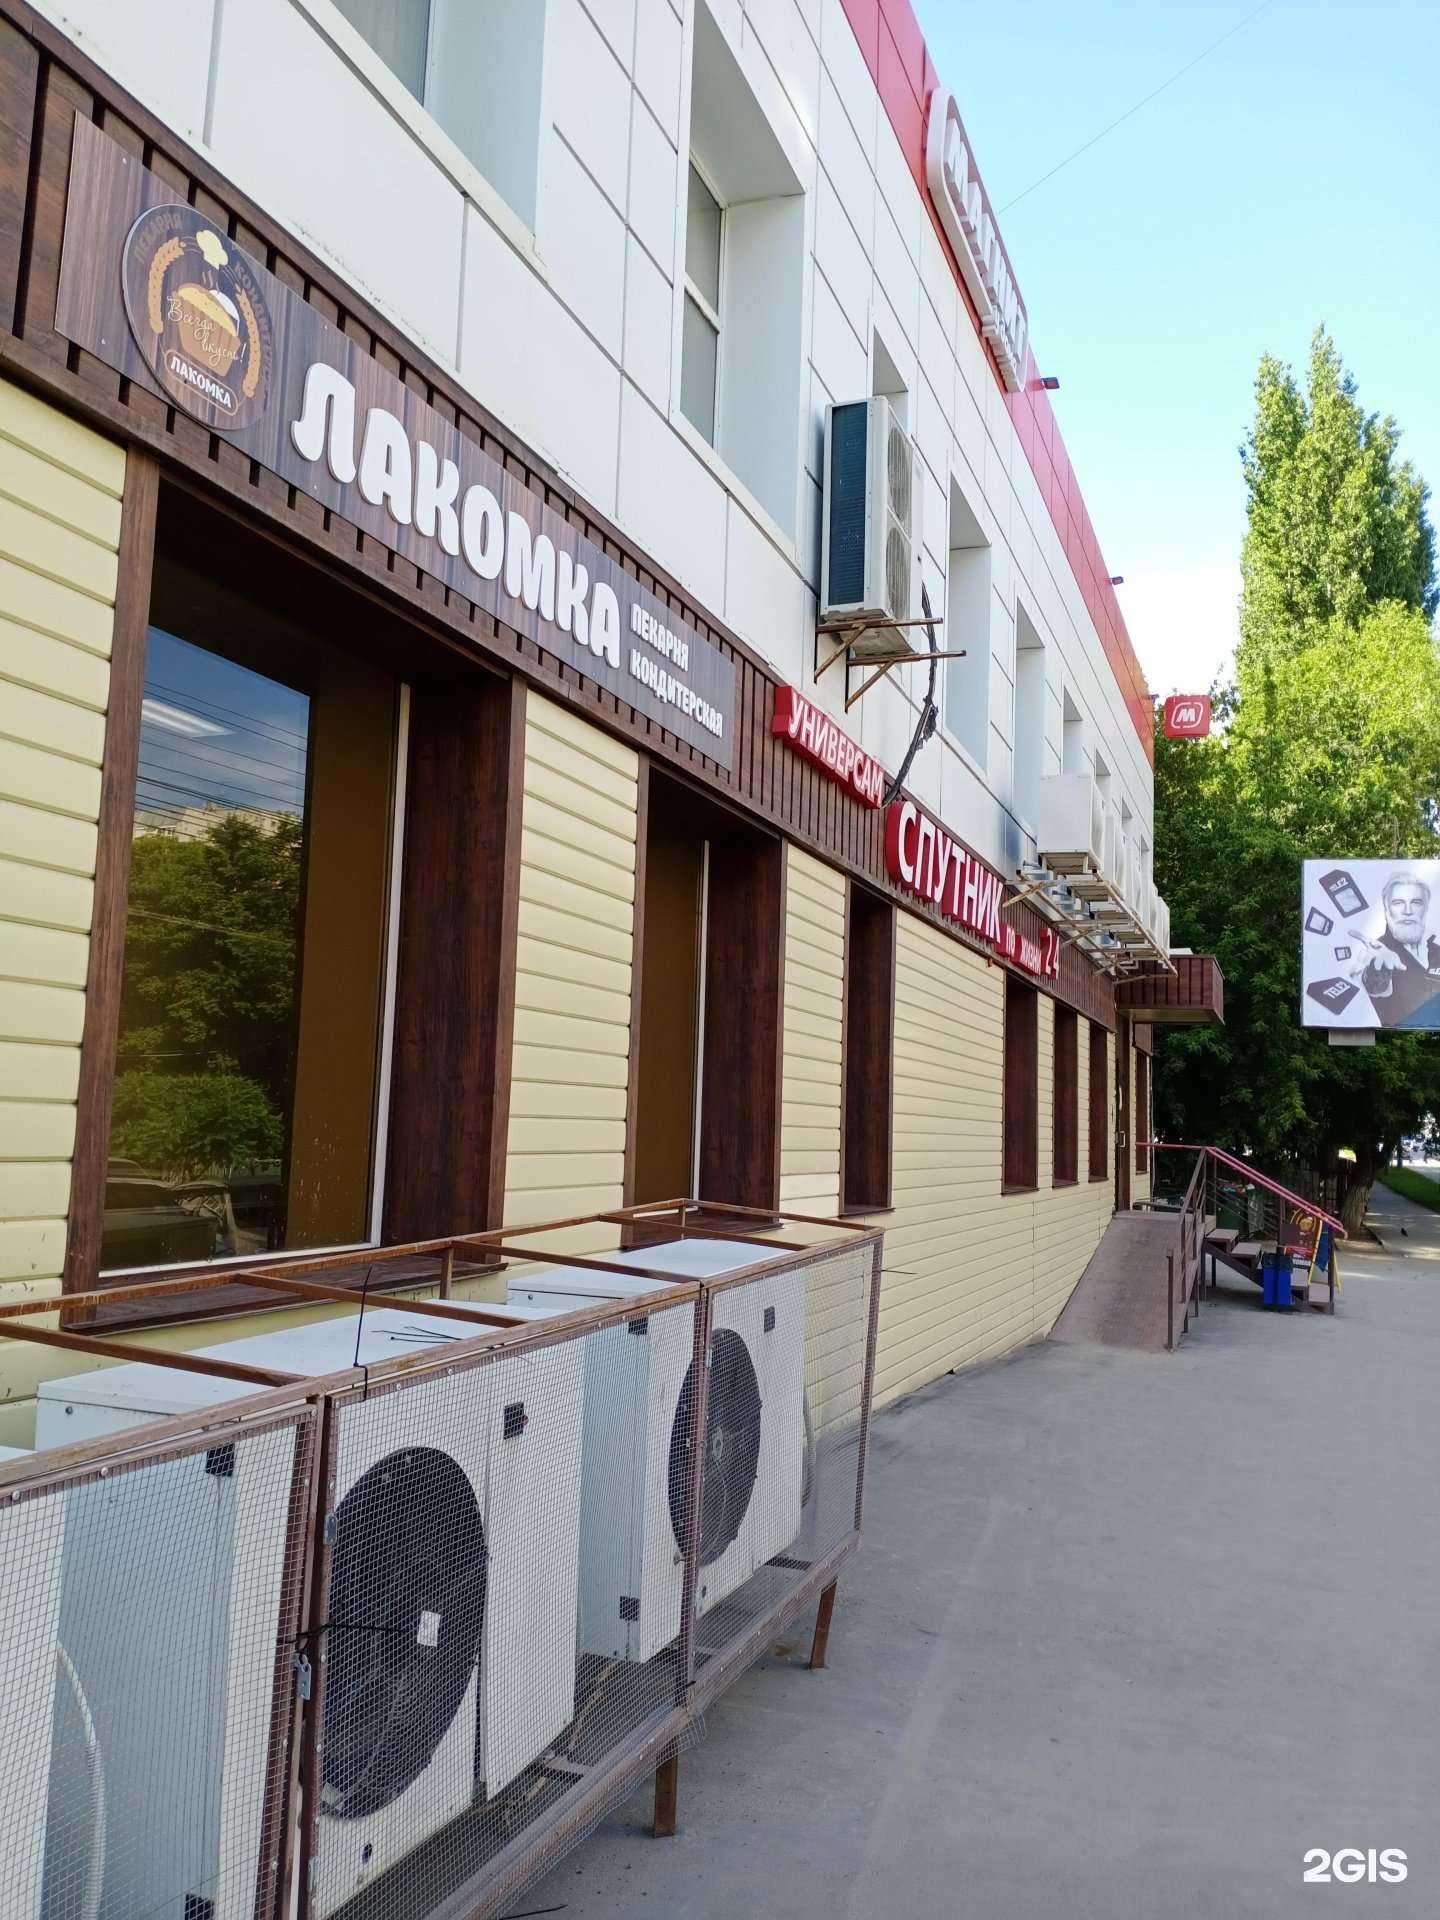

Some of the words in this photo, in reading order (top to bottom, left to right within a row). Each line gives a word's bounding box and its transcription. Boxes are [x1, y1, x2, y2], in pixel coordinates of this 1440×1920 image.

[170, 356, 232, 408] ЛАКОМКА
[291, 362, 621, 669] ЛАКОМКА
[631, 603, 689, 672] ПЕКАРНЯ
[630, 648, 723, 738] КОНДИТЕРСКАЯ
[788, 694, 885, 809] УНИВЕРСАМ
[898, 801, 1003, 944] СПУТНИК
[1045, 927, 1060, 980] 24
